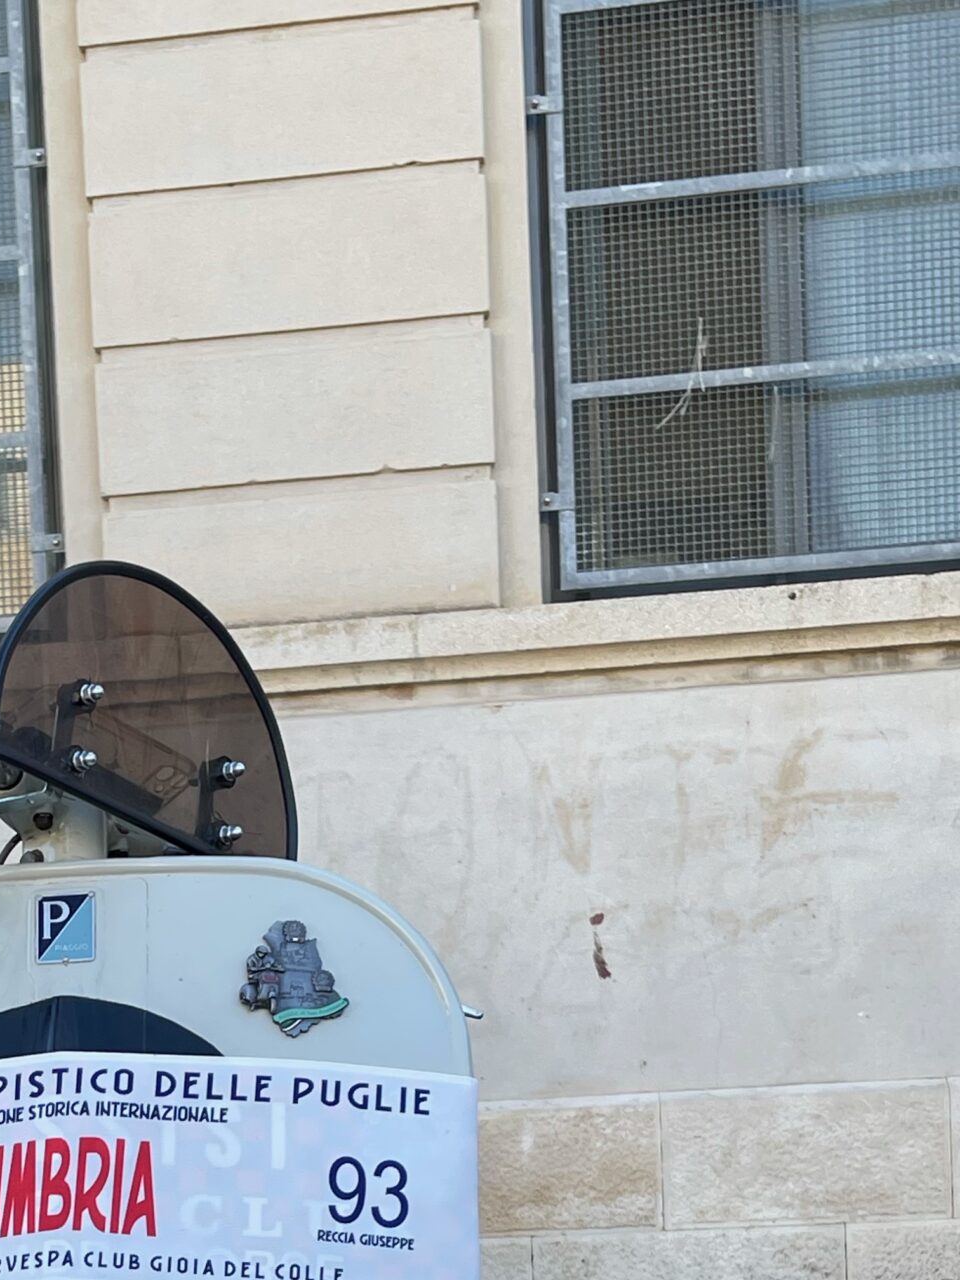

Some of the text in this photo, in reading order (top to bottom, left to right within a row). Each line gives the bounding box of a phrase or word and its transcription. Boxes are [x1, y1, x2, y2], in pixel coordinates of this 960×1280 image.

[155, 1070, 272, 1102] DELLE
[293, 1078, 431, 1116] PUGLIE
[28, 1101, 89, 1121] STORICA
[96, 1101, 228, 1123] INTERNAZIONALE
[328, 1156, 409, 1228] 93
[317, 1230, 415, 1251] RECCIA GIUSEPPE
[6, 1250, 73, 1272] VESPA
[84, 1251, 140, 1270] CLUB
[150, 1255, 214, 1277] GIOIA
[224, 1261, 265, 1280] DEL
